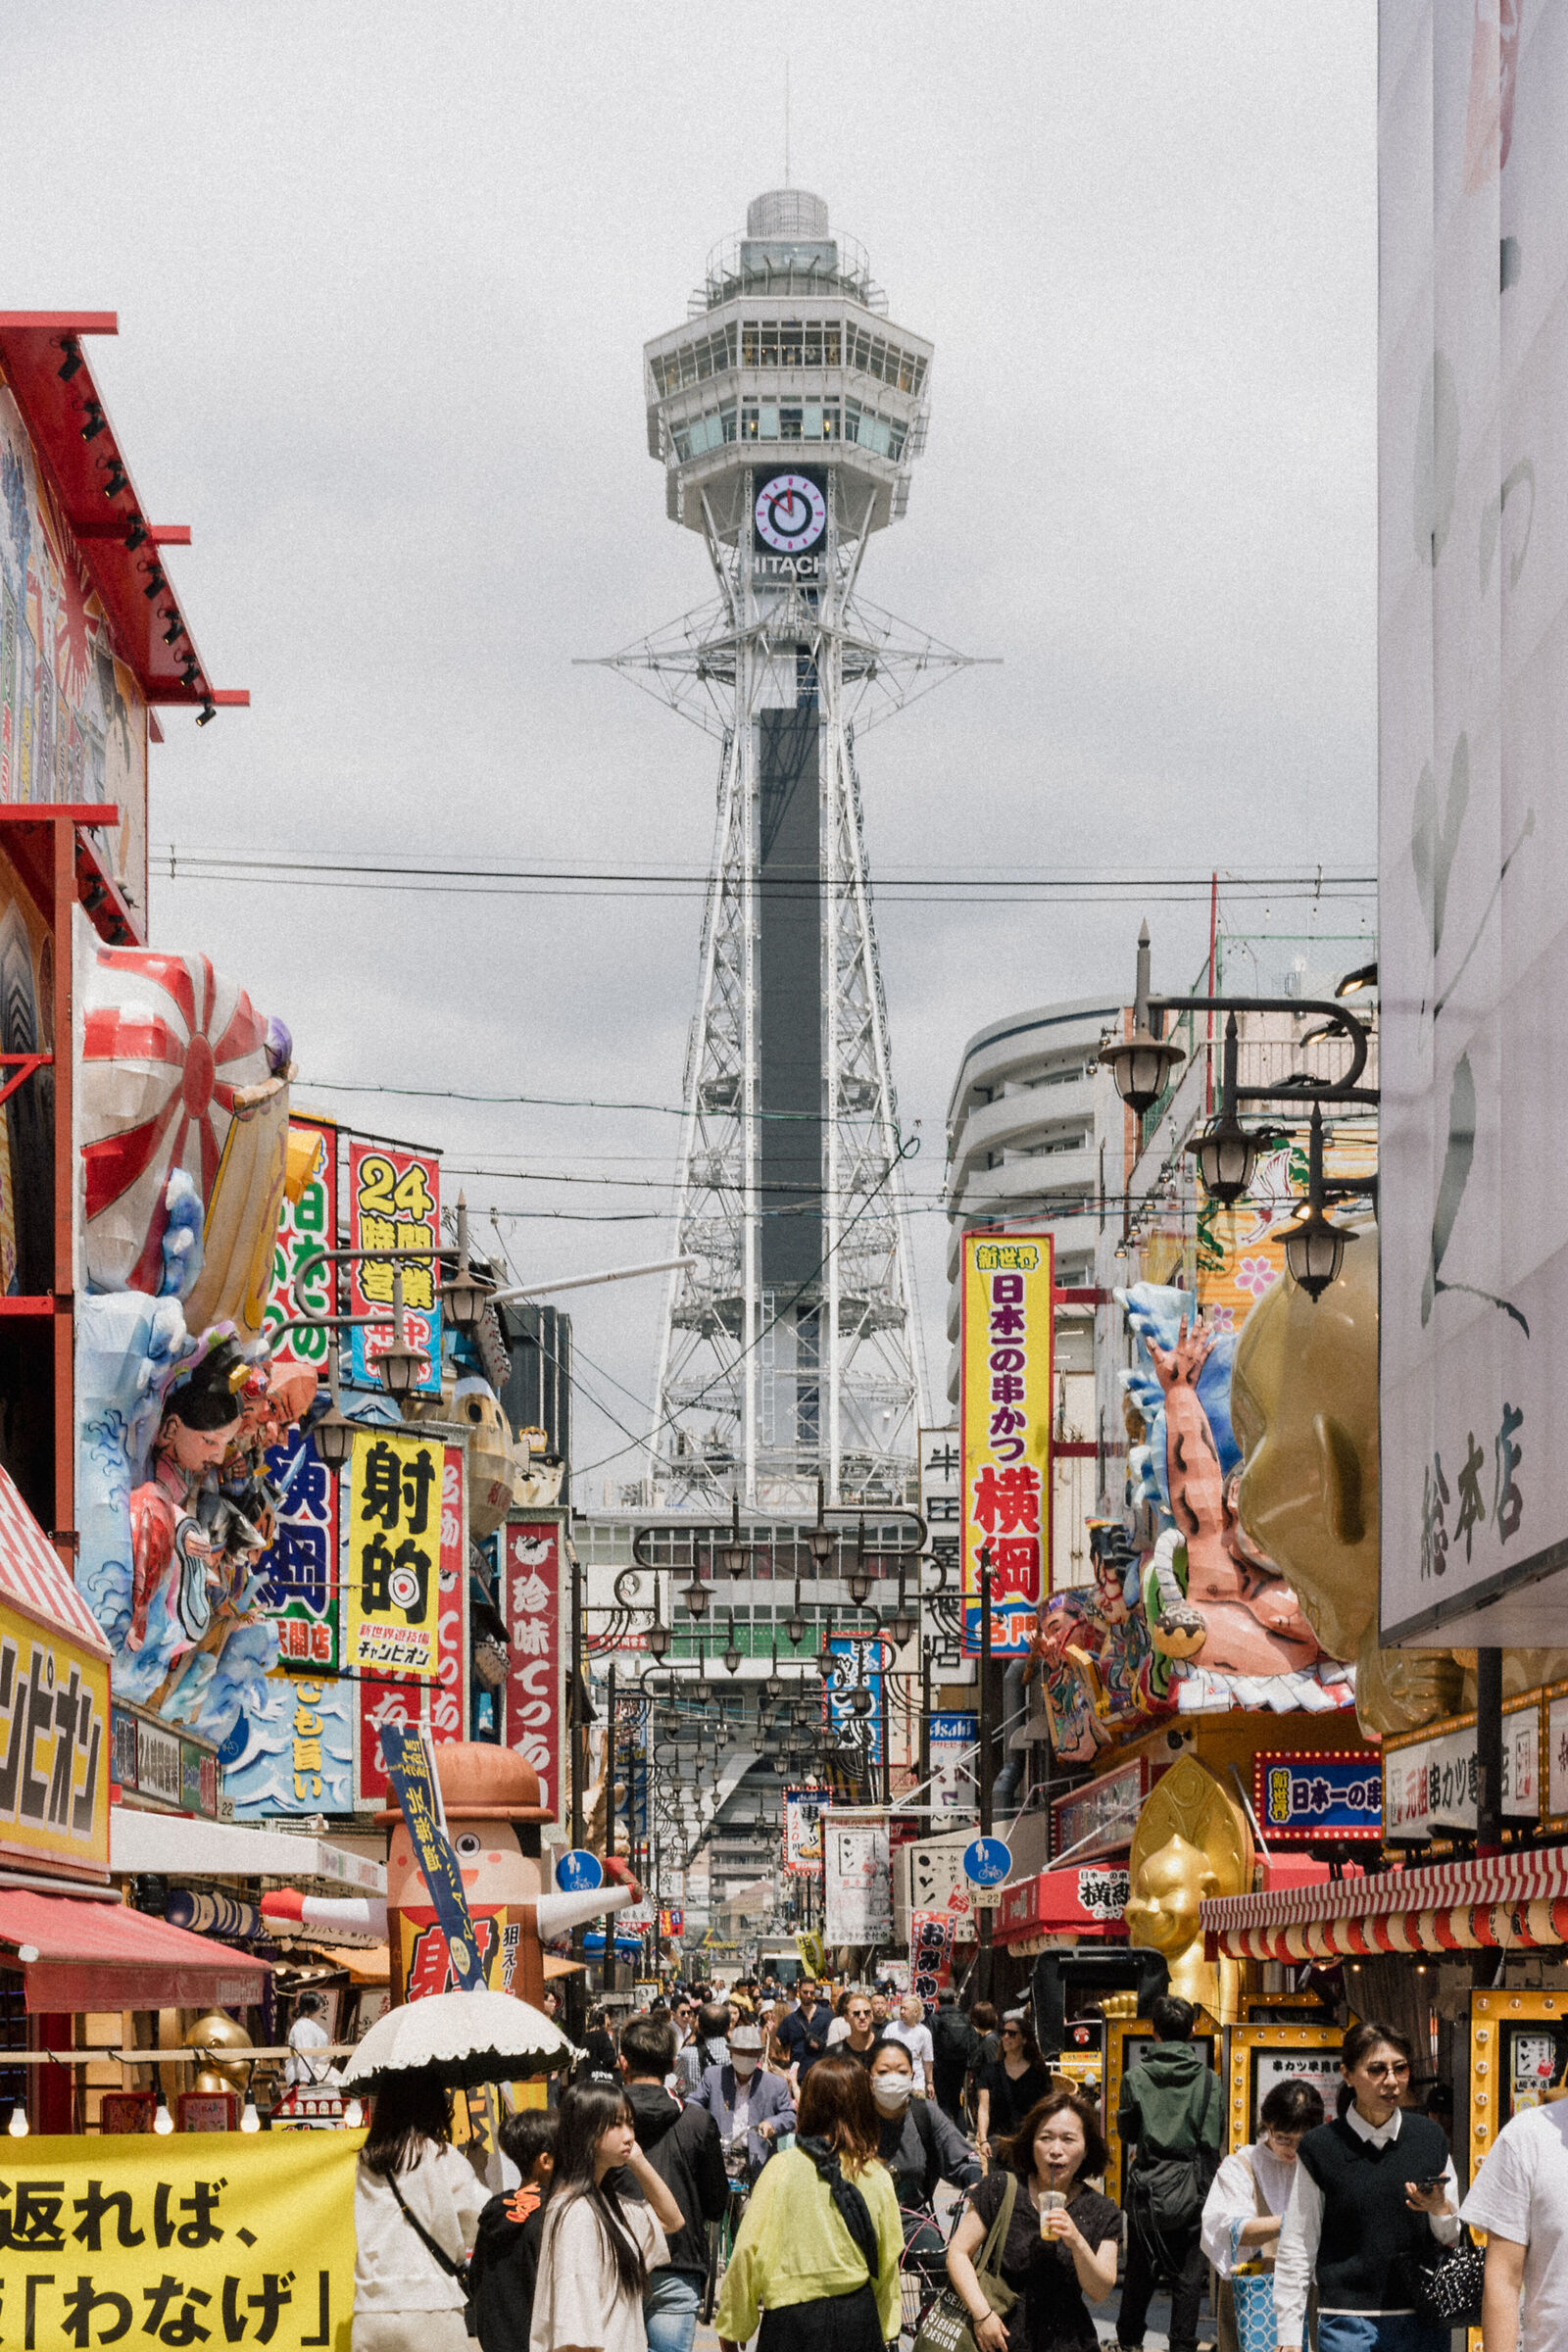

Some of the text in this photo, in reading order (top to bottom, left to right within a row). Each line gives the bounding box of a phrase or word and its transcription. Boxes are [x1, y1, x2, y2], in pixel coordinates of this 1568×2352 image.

[359, 1156, 434, 1221] 24
[976, 1245, 1039, 1271] 新世界
[989, 1274, 1027, 1462] 日本一の串かつ
[361, 1441, 436, 1625] 射的
[973, 1466, 1042, 1604] 横綱
[930, 1719, 971, 1738] Asahi
[1292, 1779, 1382, 1812] 日本一の串
[0, 2177, 258, 2251] 返れば、
[0, 2270, 330, 2352] 「わなげ」
